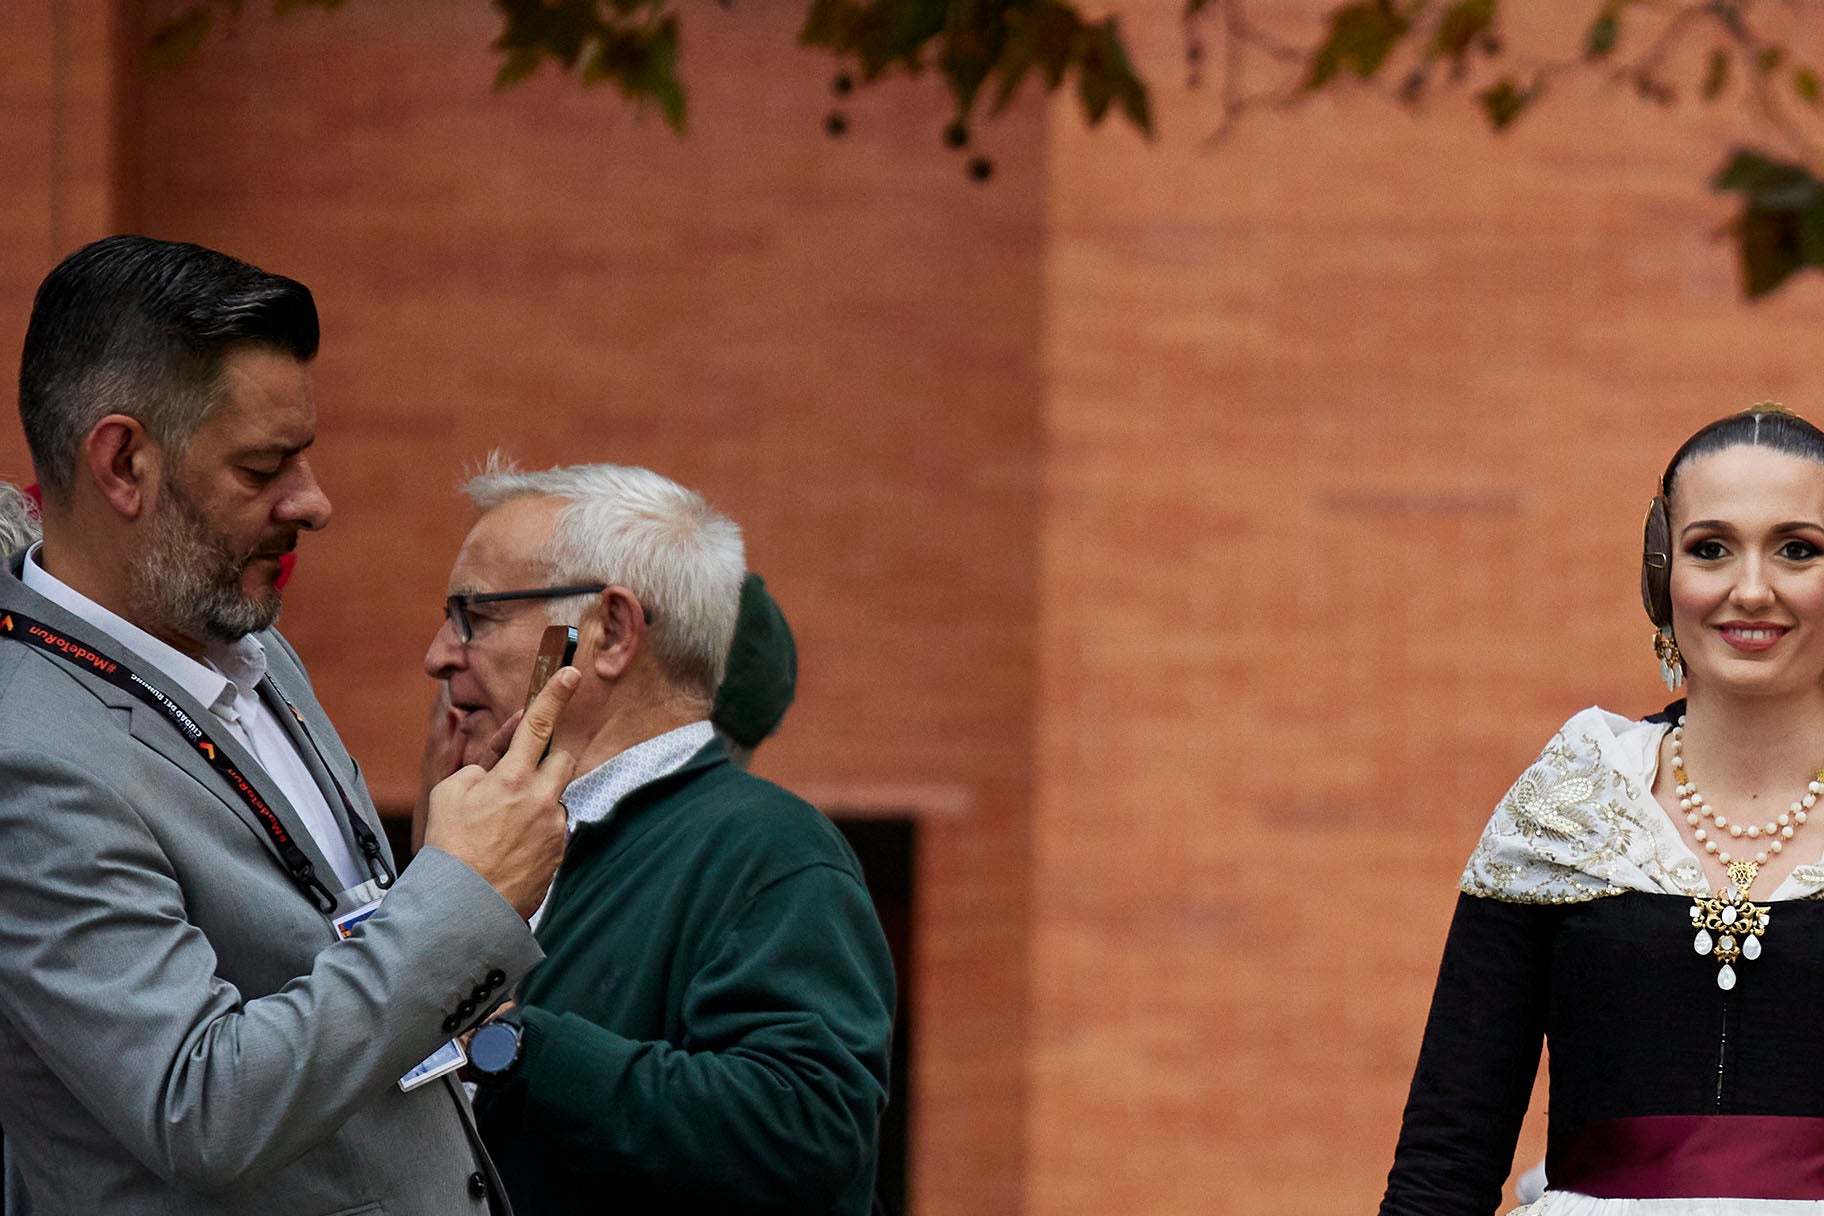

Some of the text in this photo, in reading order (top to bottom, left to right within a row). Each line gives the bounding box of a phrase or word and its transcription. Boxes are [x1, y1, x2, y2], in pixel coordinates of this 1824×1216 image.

[28, 626, 118, 673] #MadeToRun
[163, 698, 178, 712] DEL
[176, 710, 203, 738] CIUDAD
